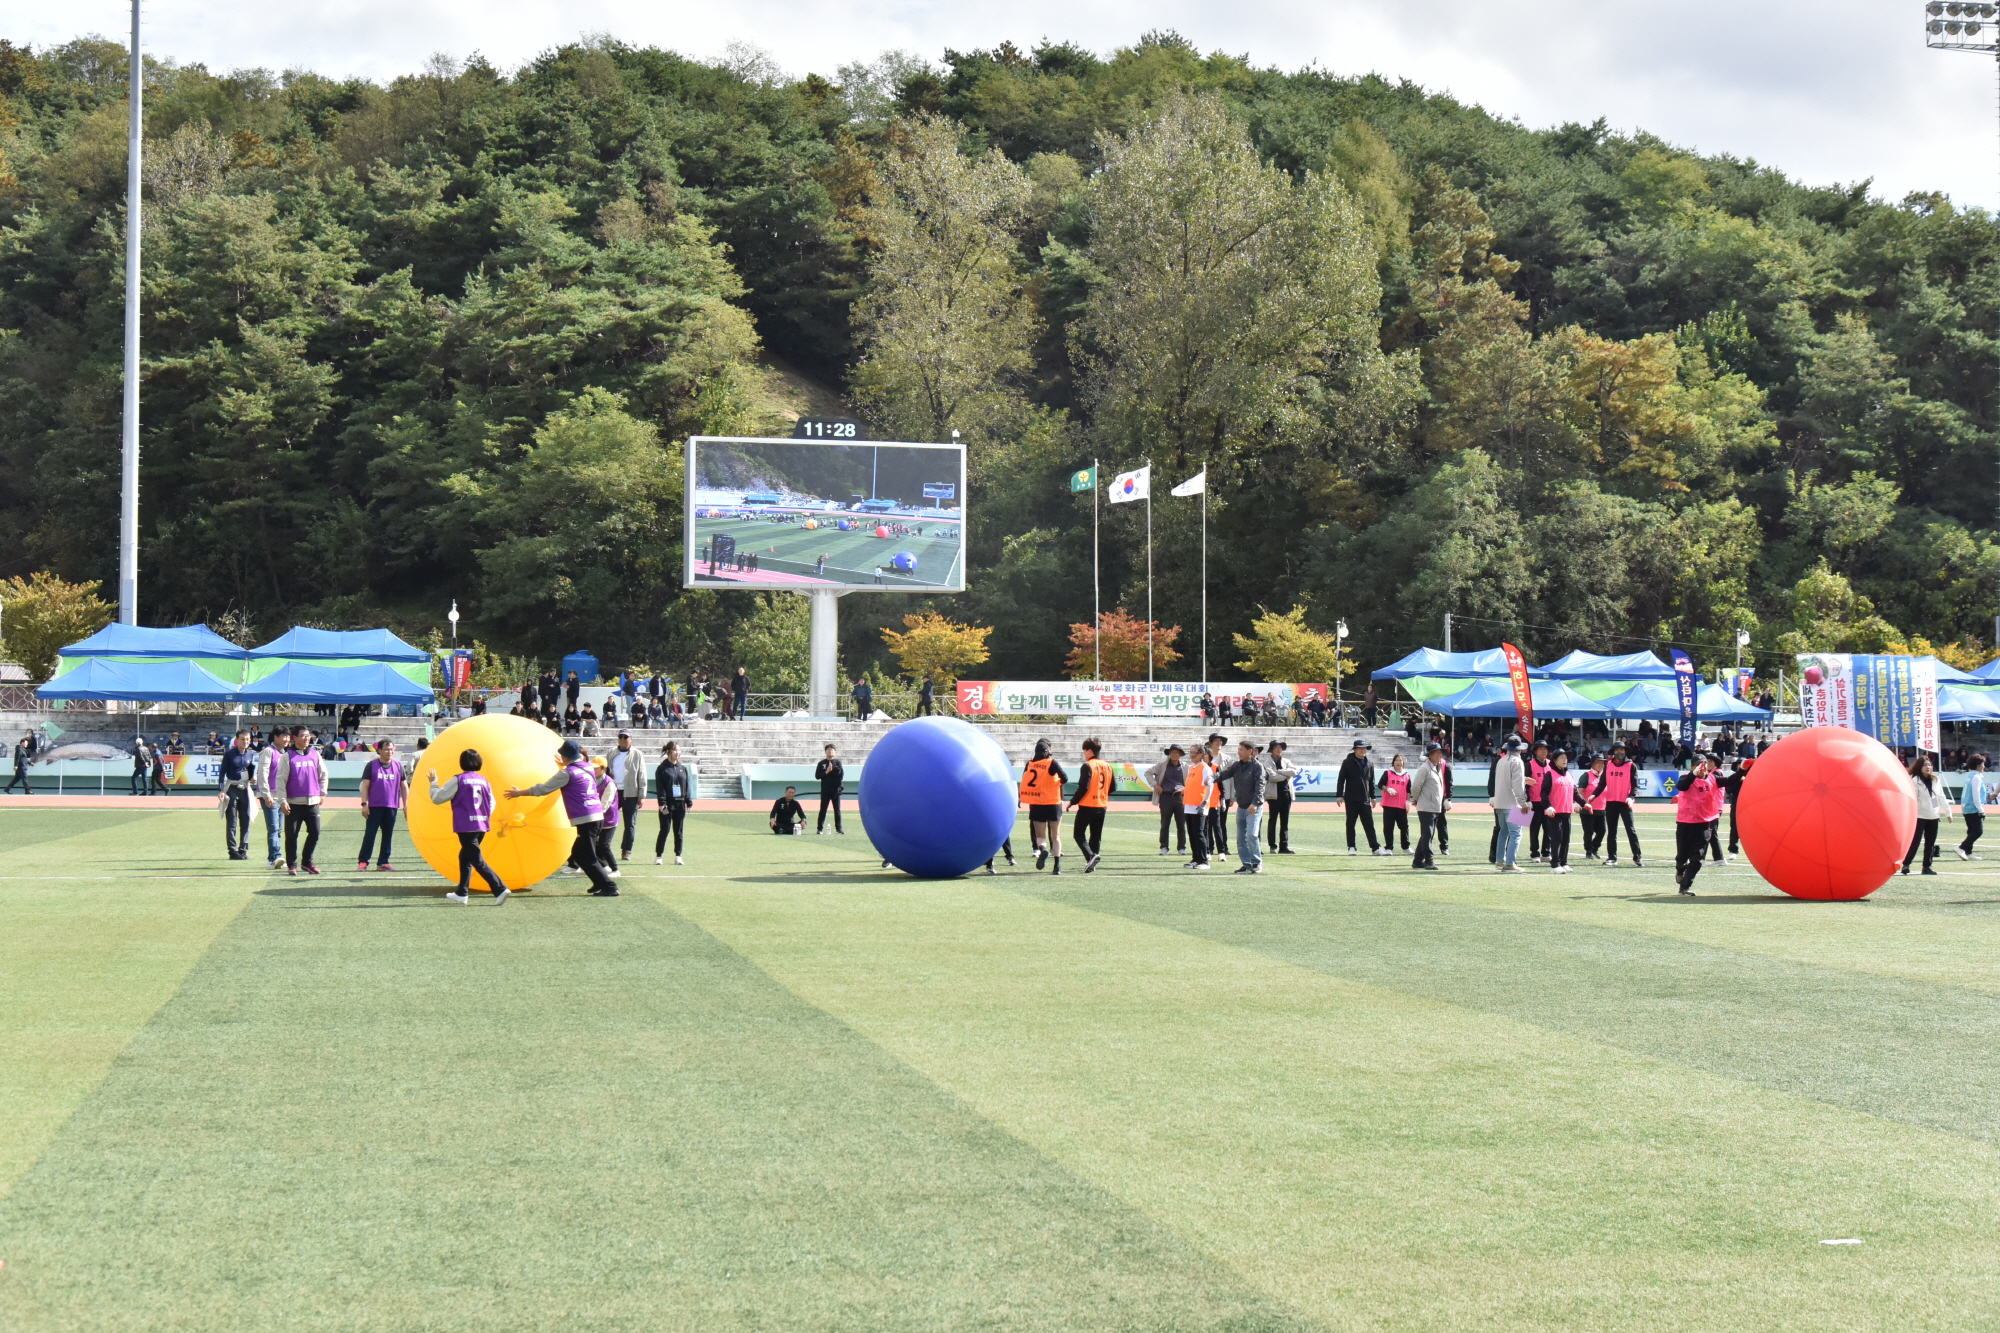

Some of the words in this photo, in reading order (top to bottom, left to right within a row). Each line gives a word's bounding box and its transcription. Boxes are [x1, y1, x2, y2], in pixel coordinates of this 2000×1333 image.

[804, 422, 856, 437] 11:28
[1088, 683, 1111, 692] 제44회
[1112, 683, 1209, 693] 봉화군민체육대회
[963, 685, 984, 710] 경
[1007, 693, 1048, 711] 함께
[1054, 694, 1093, 711] 뛰는
[1098, 694, 1145, 711] 봉화!
[163, 761, 175, 779] 필
[1027, 768, 1038, 787] 2
[582, 773, 595, 795] 2
[1098, 772, 1105, 789] 9
[1662, 776, 1677, 793] 승
[472, 785, 483, 810] 5
